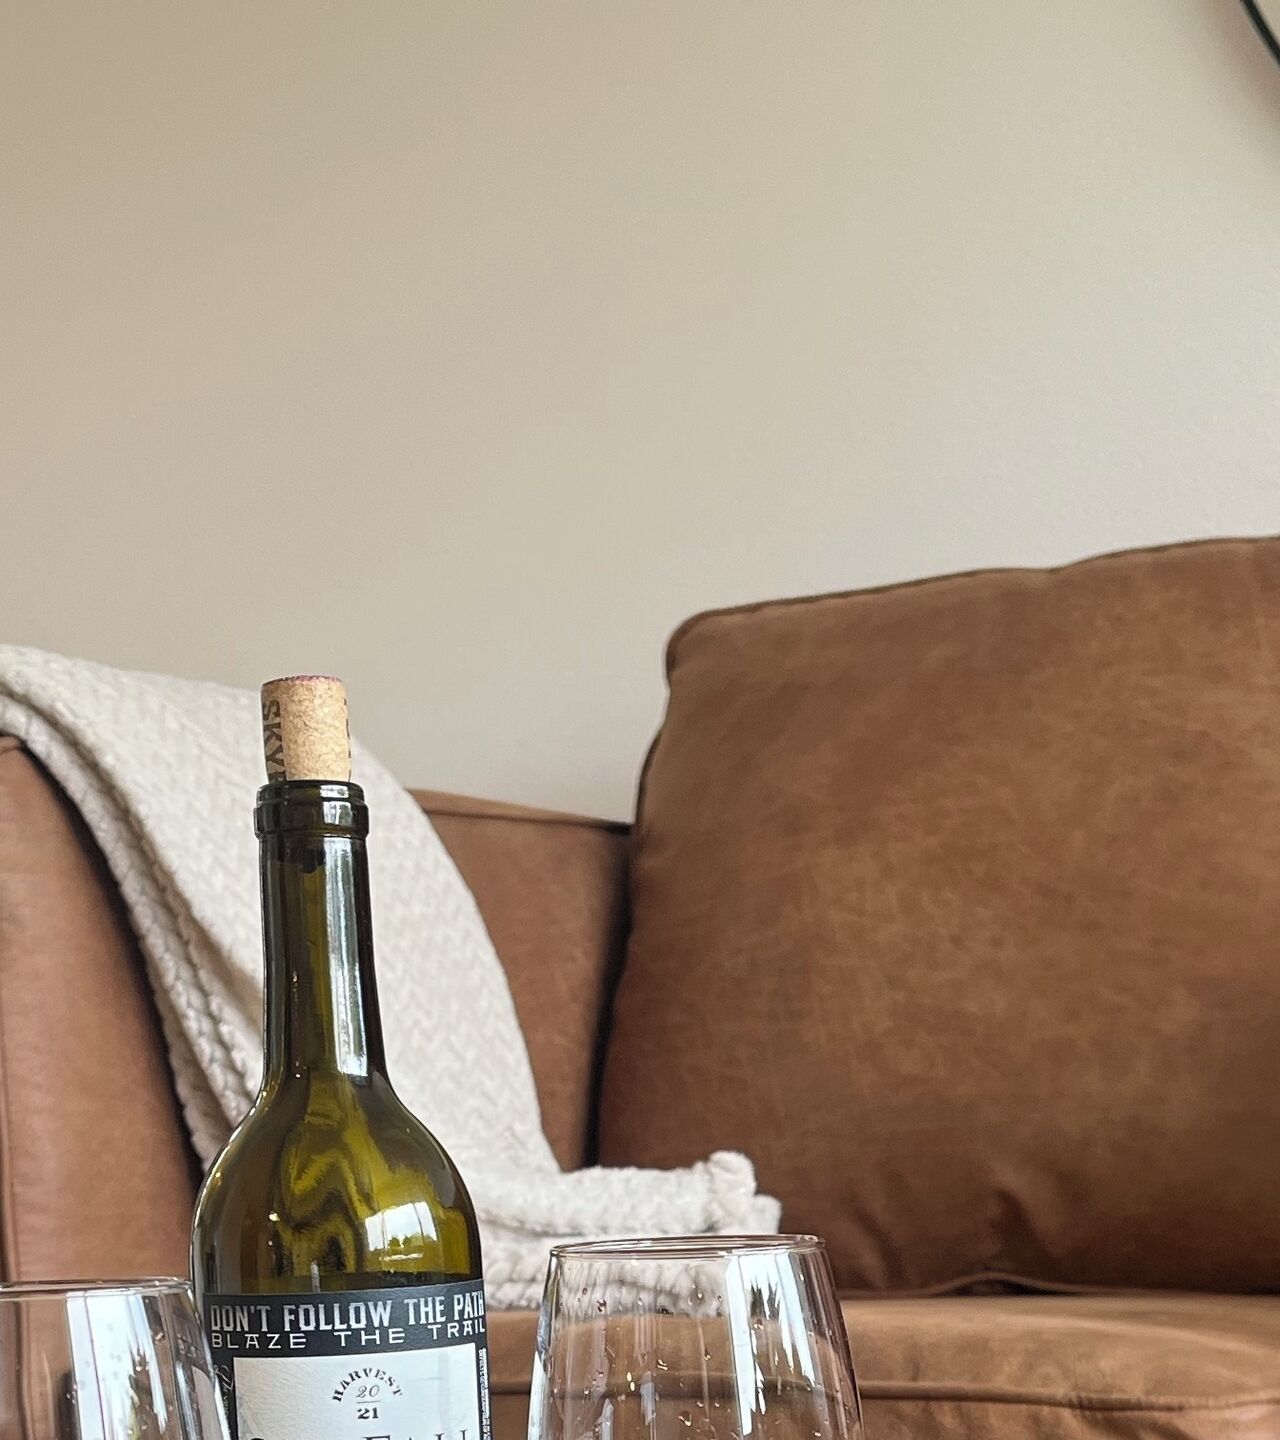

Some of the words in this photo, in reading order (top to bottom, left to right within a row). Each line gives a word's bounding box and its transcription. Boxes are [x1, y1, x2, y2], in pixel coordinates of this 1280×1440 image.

[210, 1305, 271, 1332] DON'T
[284, 1300, 393, 1331] FOLLOW
[404, 1296, 446, 1325] THE
[454, 1291, 485, 1321] PATH
[212, 1334, 307, 1349] BLAZE
[334, 1328, 405, 1346] THE
[428, 1319, 486, 1341] TRAIL
[331, 1367, 403, 1402] HARVEST
[355, 1384, 380, 1398] 20
[356, 1407, 379, 1420] 21
